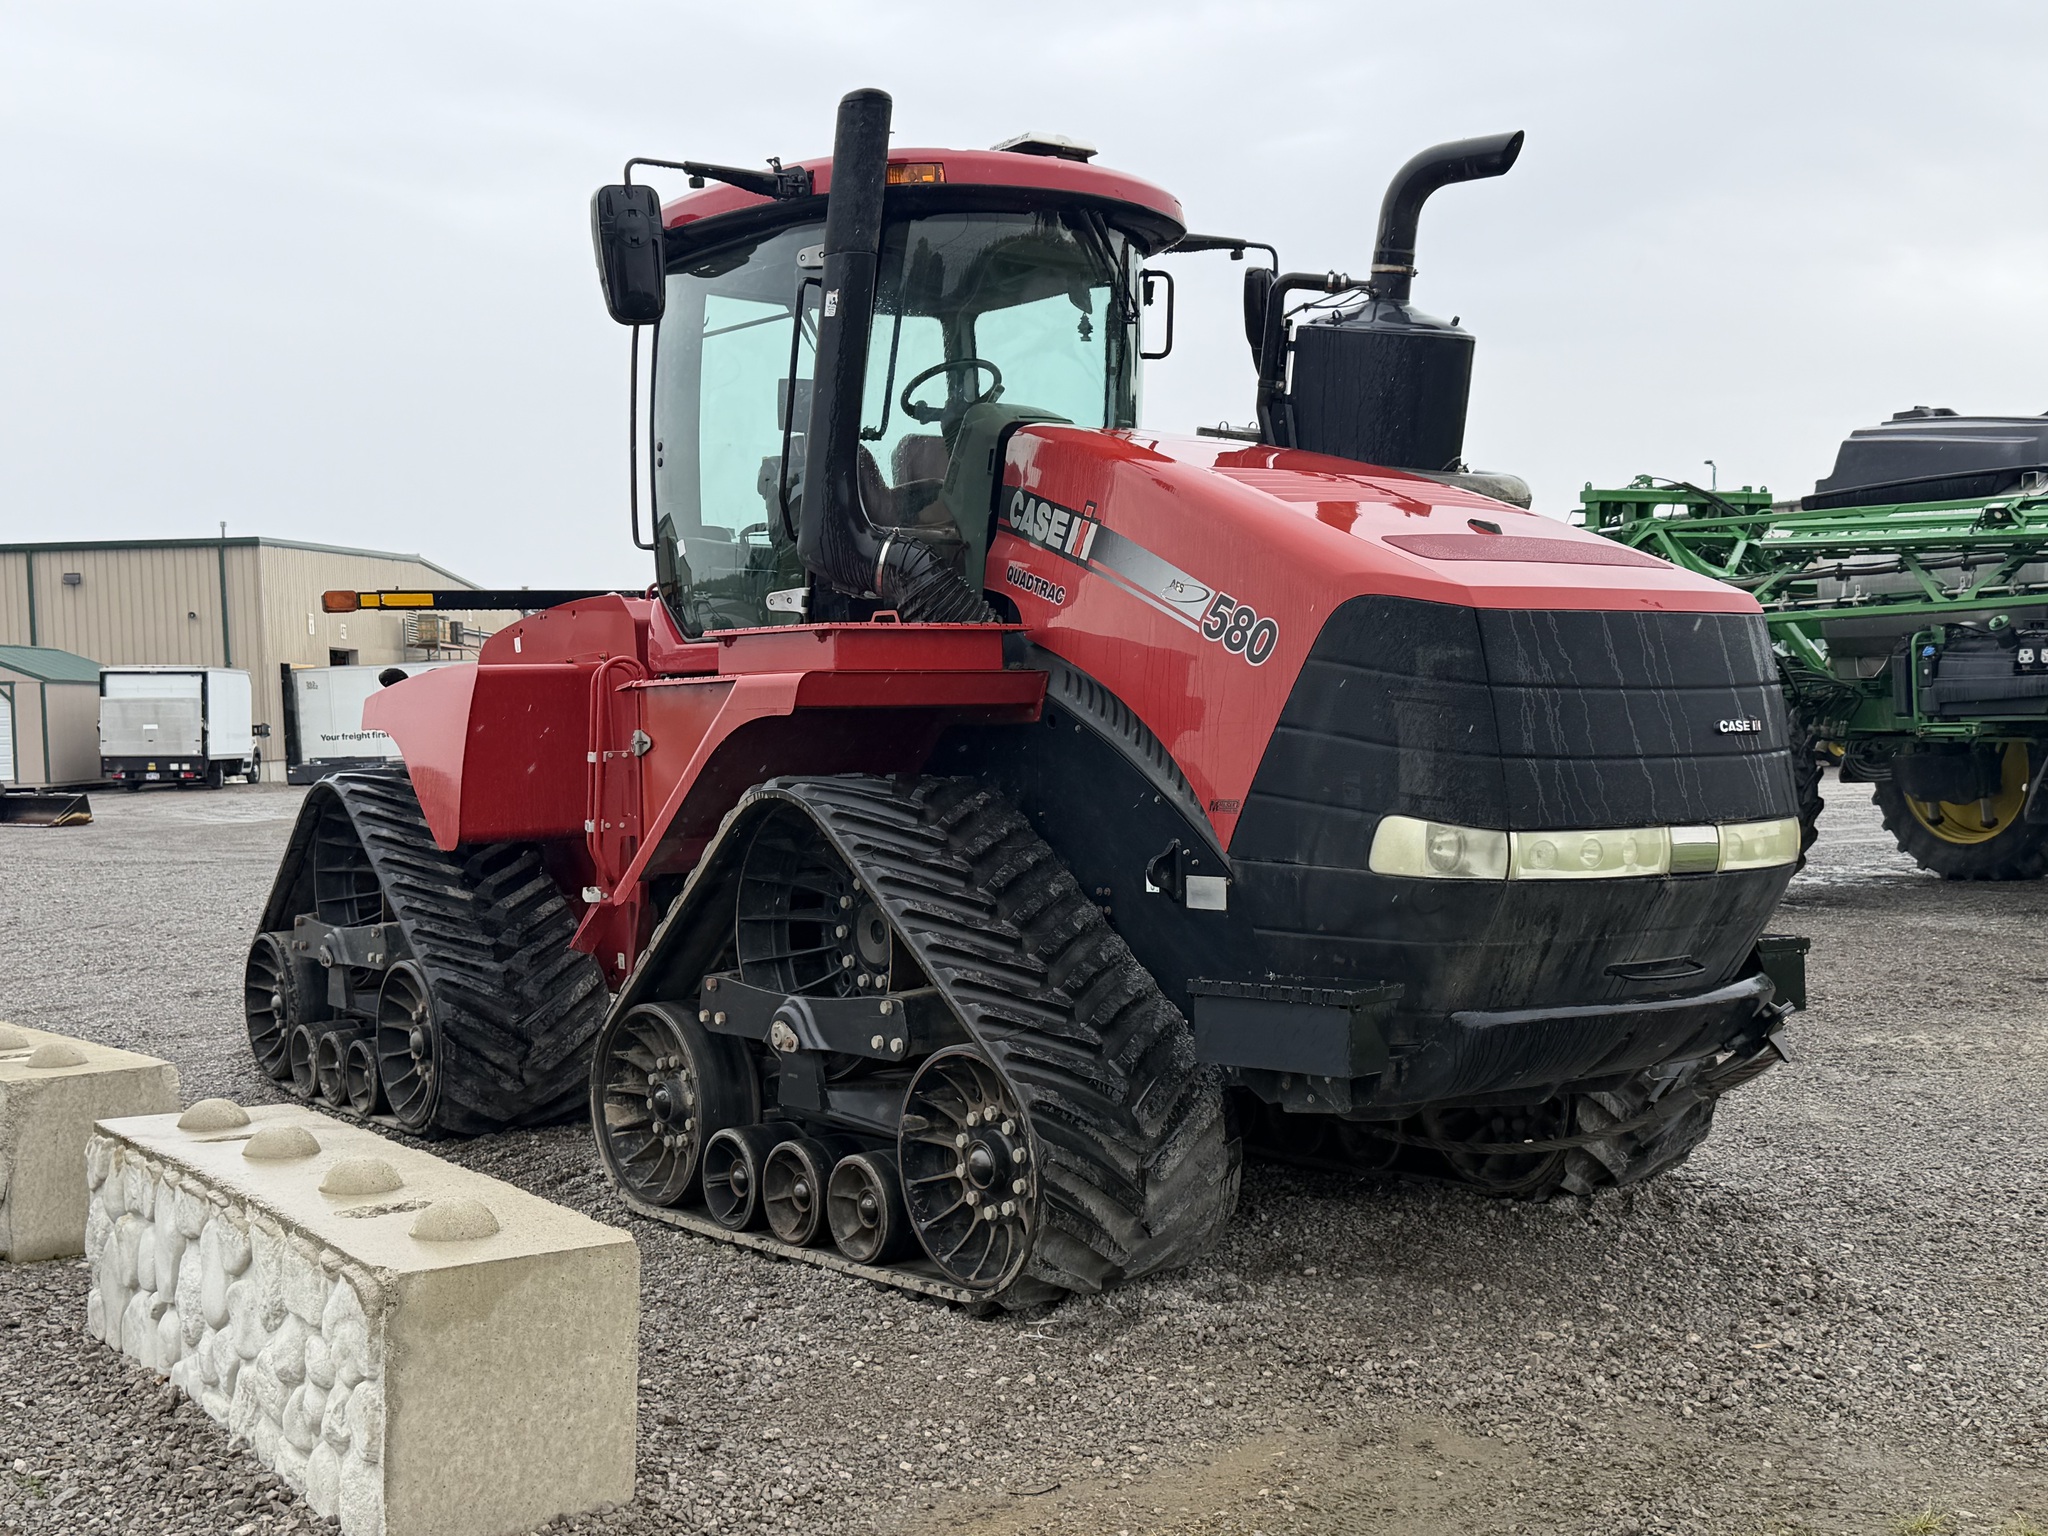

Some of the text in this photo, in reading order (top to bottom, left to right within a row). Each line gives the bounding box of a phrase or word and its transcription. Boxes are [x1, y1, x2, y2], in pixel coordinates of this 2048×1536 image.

[1009, 490, 1070, 549] CASE
[1006, 565, 1066, 606] QUADTRAC
[1201, 591, 1279, 667] 580
[320, 734, 340, 742] Your
[341, 732, 371, 742] freight
[1719, 720, 1751, 733] CASE
